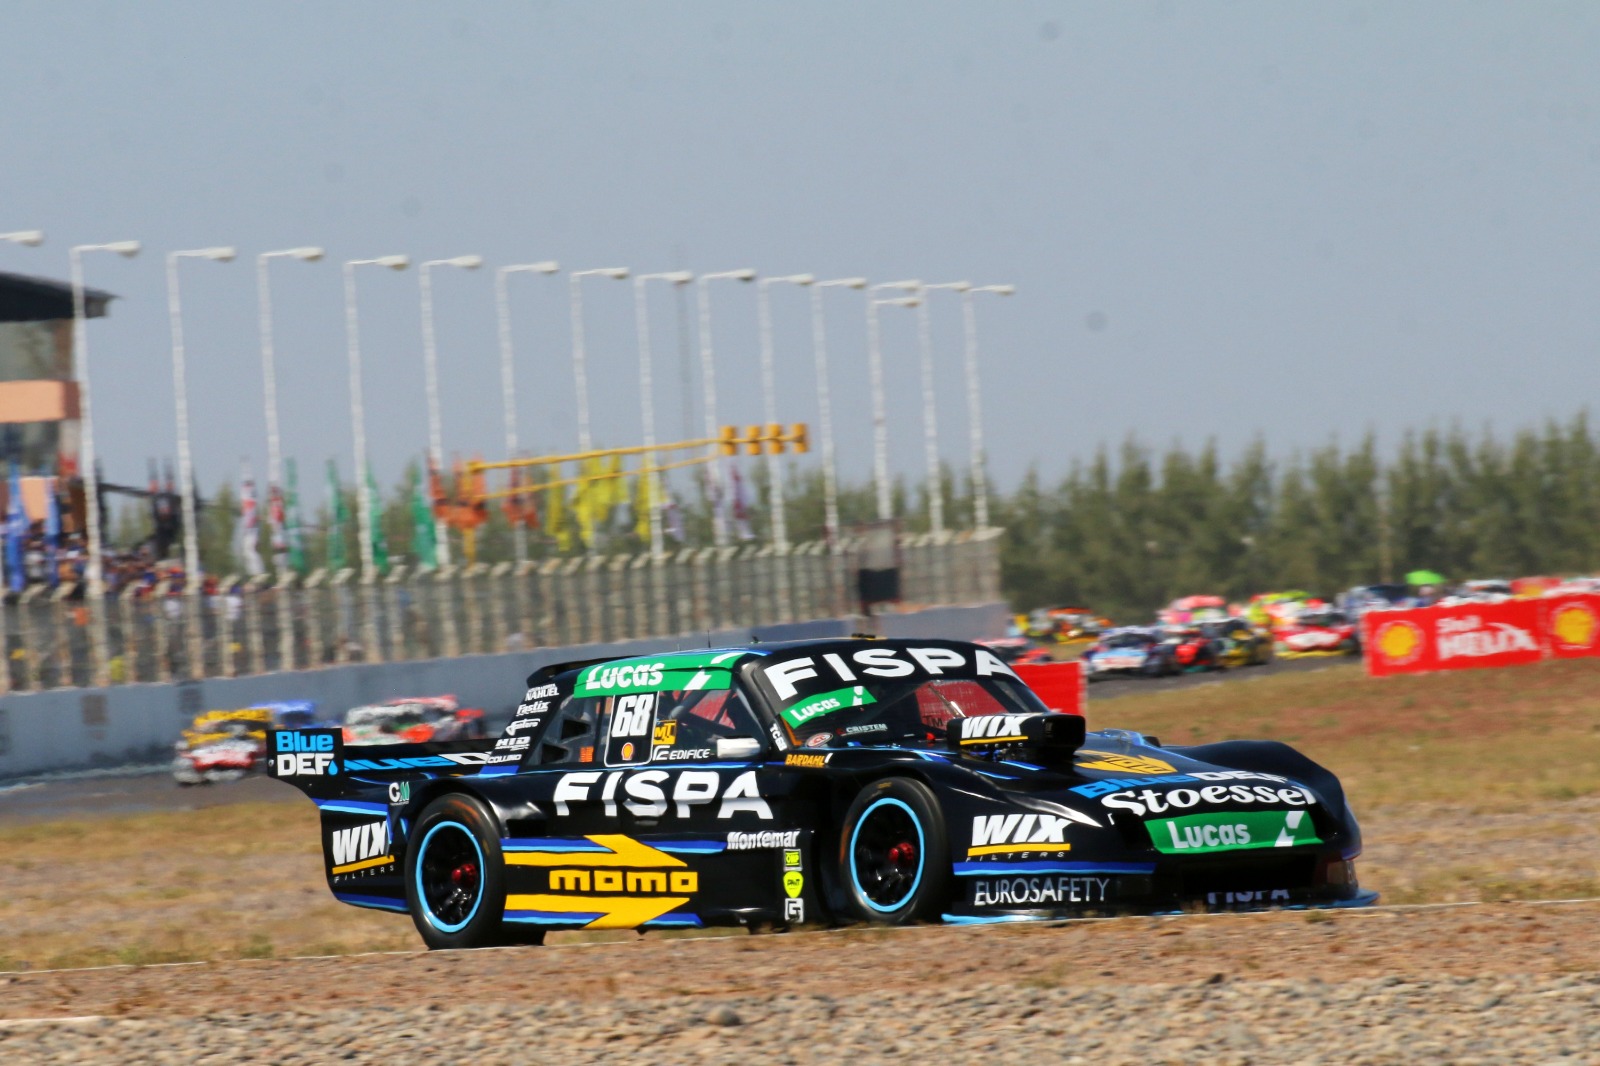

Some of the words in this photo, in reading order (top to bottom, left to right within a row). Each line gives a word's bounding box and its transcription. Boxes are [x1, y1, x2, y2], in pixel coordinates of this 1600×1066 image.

[586, 662, 665, 690] Lucas
[764, 648, 1028, 701] FISPA
[611, 694, 654, 738] 68
[790, 698, 841, 721] Lucas
[961, 716, 1034, 738] WIX
[276, 731, 334, 752] Blue
[669, 748, 711, 760] EDIFICE
[277, 752, 335, 776] DEF
[785, 753, 826, 768] BARDAHL
[553, 771, 774, 826] FISPA
[1100, 785, 1318, 824] Stoessel
[332, 821, 391, 865] WIX
[726, 830, 800, 850] Montemar
[971, 813, 1074, 847] WIX
[1166, 821, 1251, 849] Lucas
[333, 864, 395, 884] FILTERS
[549, 869, 699, 893] momo
[973, 876, 1111, 907] EUROSAFETY
